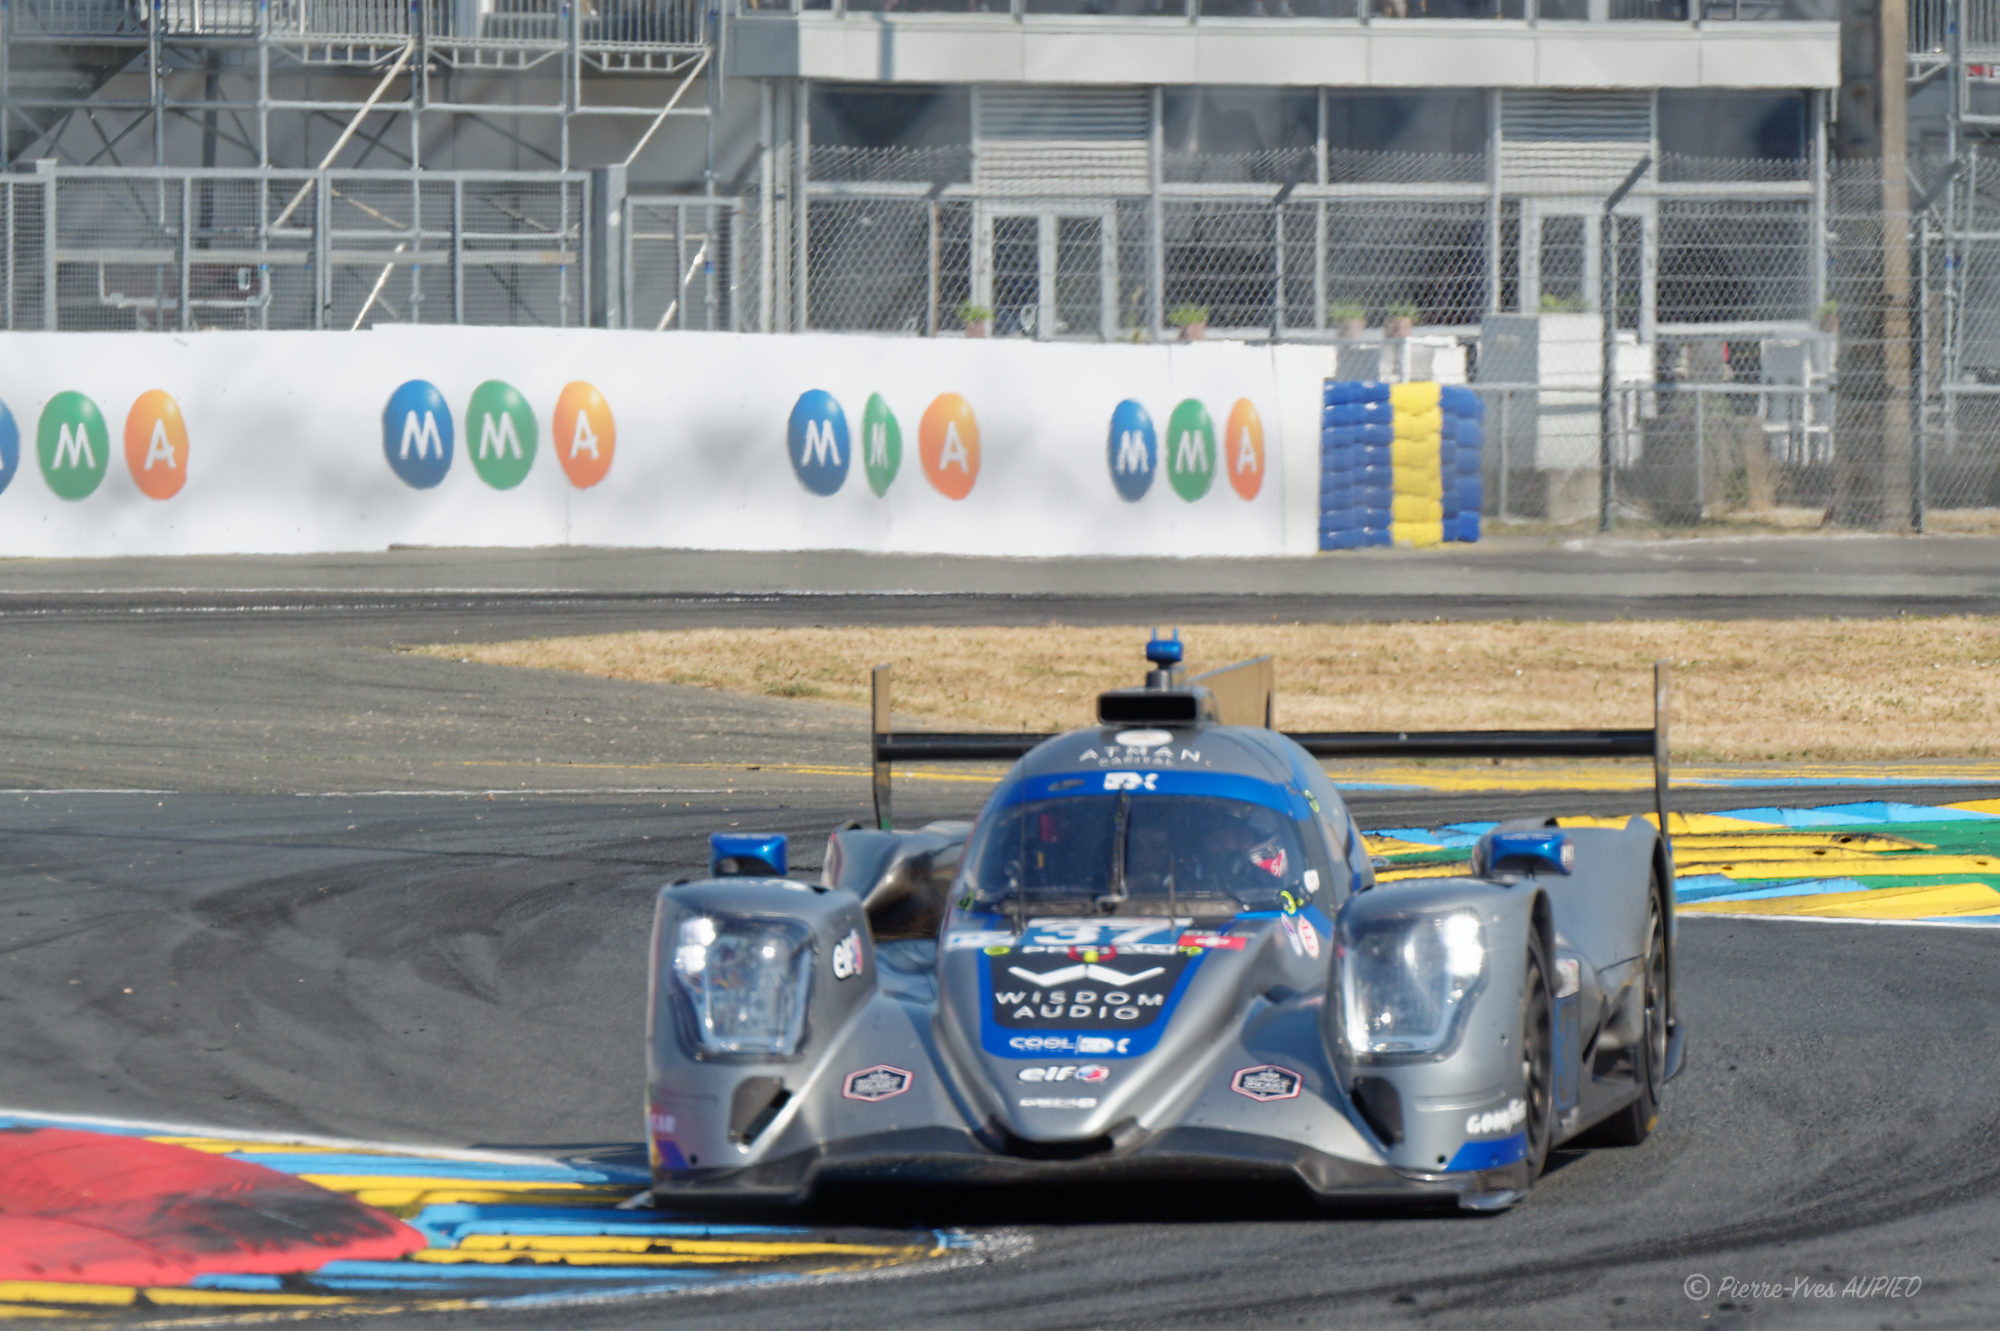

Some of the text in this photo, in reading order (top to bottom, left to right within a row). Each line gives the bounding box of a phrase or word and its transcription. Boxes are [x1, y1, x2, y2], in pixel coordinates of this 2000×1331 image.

[0, 418, 177, 470] MA
[400, 409, 600, 460] MMA
[802, 419, 969, 473] MMA
[1115, 426, 1257, 474] MMA
[995, 991, 1164, 1006] WISDOM
[1013, 1005, 1140, 1020] AUDIO
[1009, 1036, 1075, 1050] COOL
